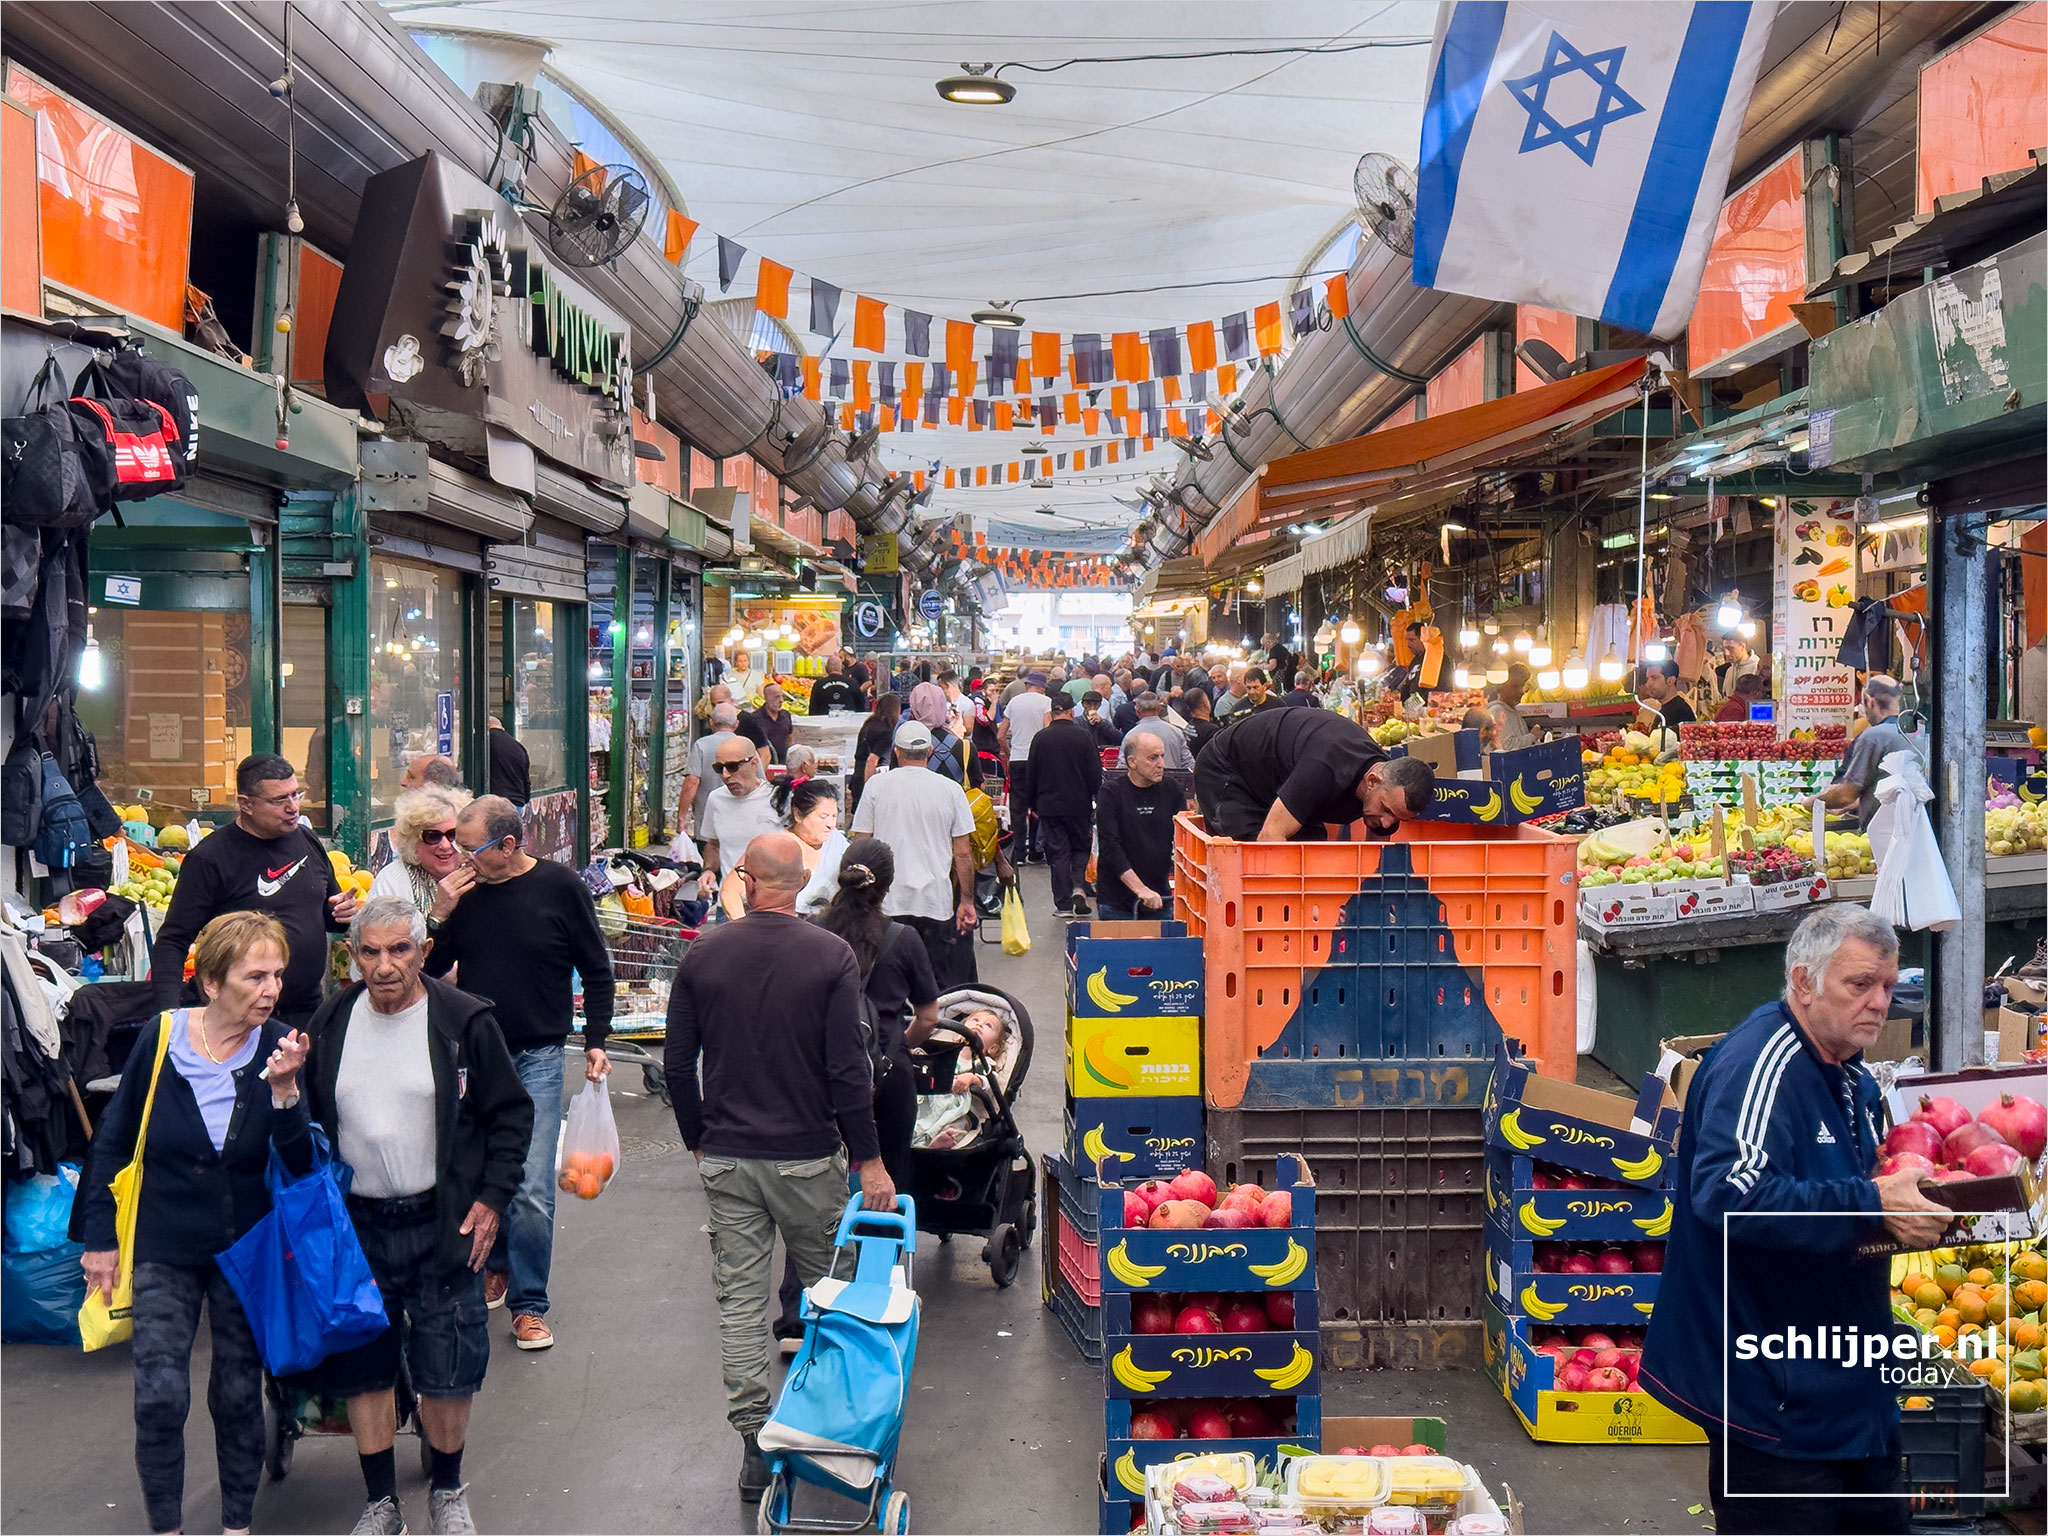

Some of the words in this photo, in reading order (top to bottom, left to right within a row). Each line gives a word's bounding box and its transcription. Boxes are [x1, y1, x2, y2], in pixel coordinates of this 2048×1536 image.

[183, 394, 199, 461] NIKE
[1812, 617, 1833, 632] רז
[1798, 637, 1844, 650] פירות
[1549, 774, 1581, 789] הבננה
[1691, 907, 1712, 915] מובחר
[1149, 980, 1199, 993] הבננה
[1141, 1064, 1190, 1074] בננות
[1550, 1123, 1615, 1149] הבננה
[1145, 1137, 1195, 1151] הבננה
[1567, 1200, 1633, 1217] הבננה
[1166, 1243, 1248, 1263] הבננה
[1568, 1285, 1634, 1301] הבננה
[1171, 1347, 1253, 1368] הבננה
[1608, 1426, 1643, 1437] QUERIDA
